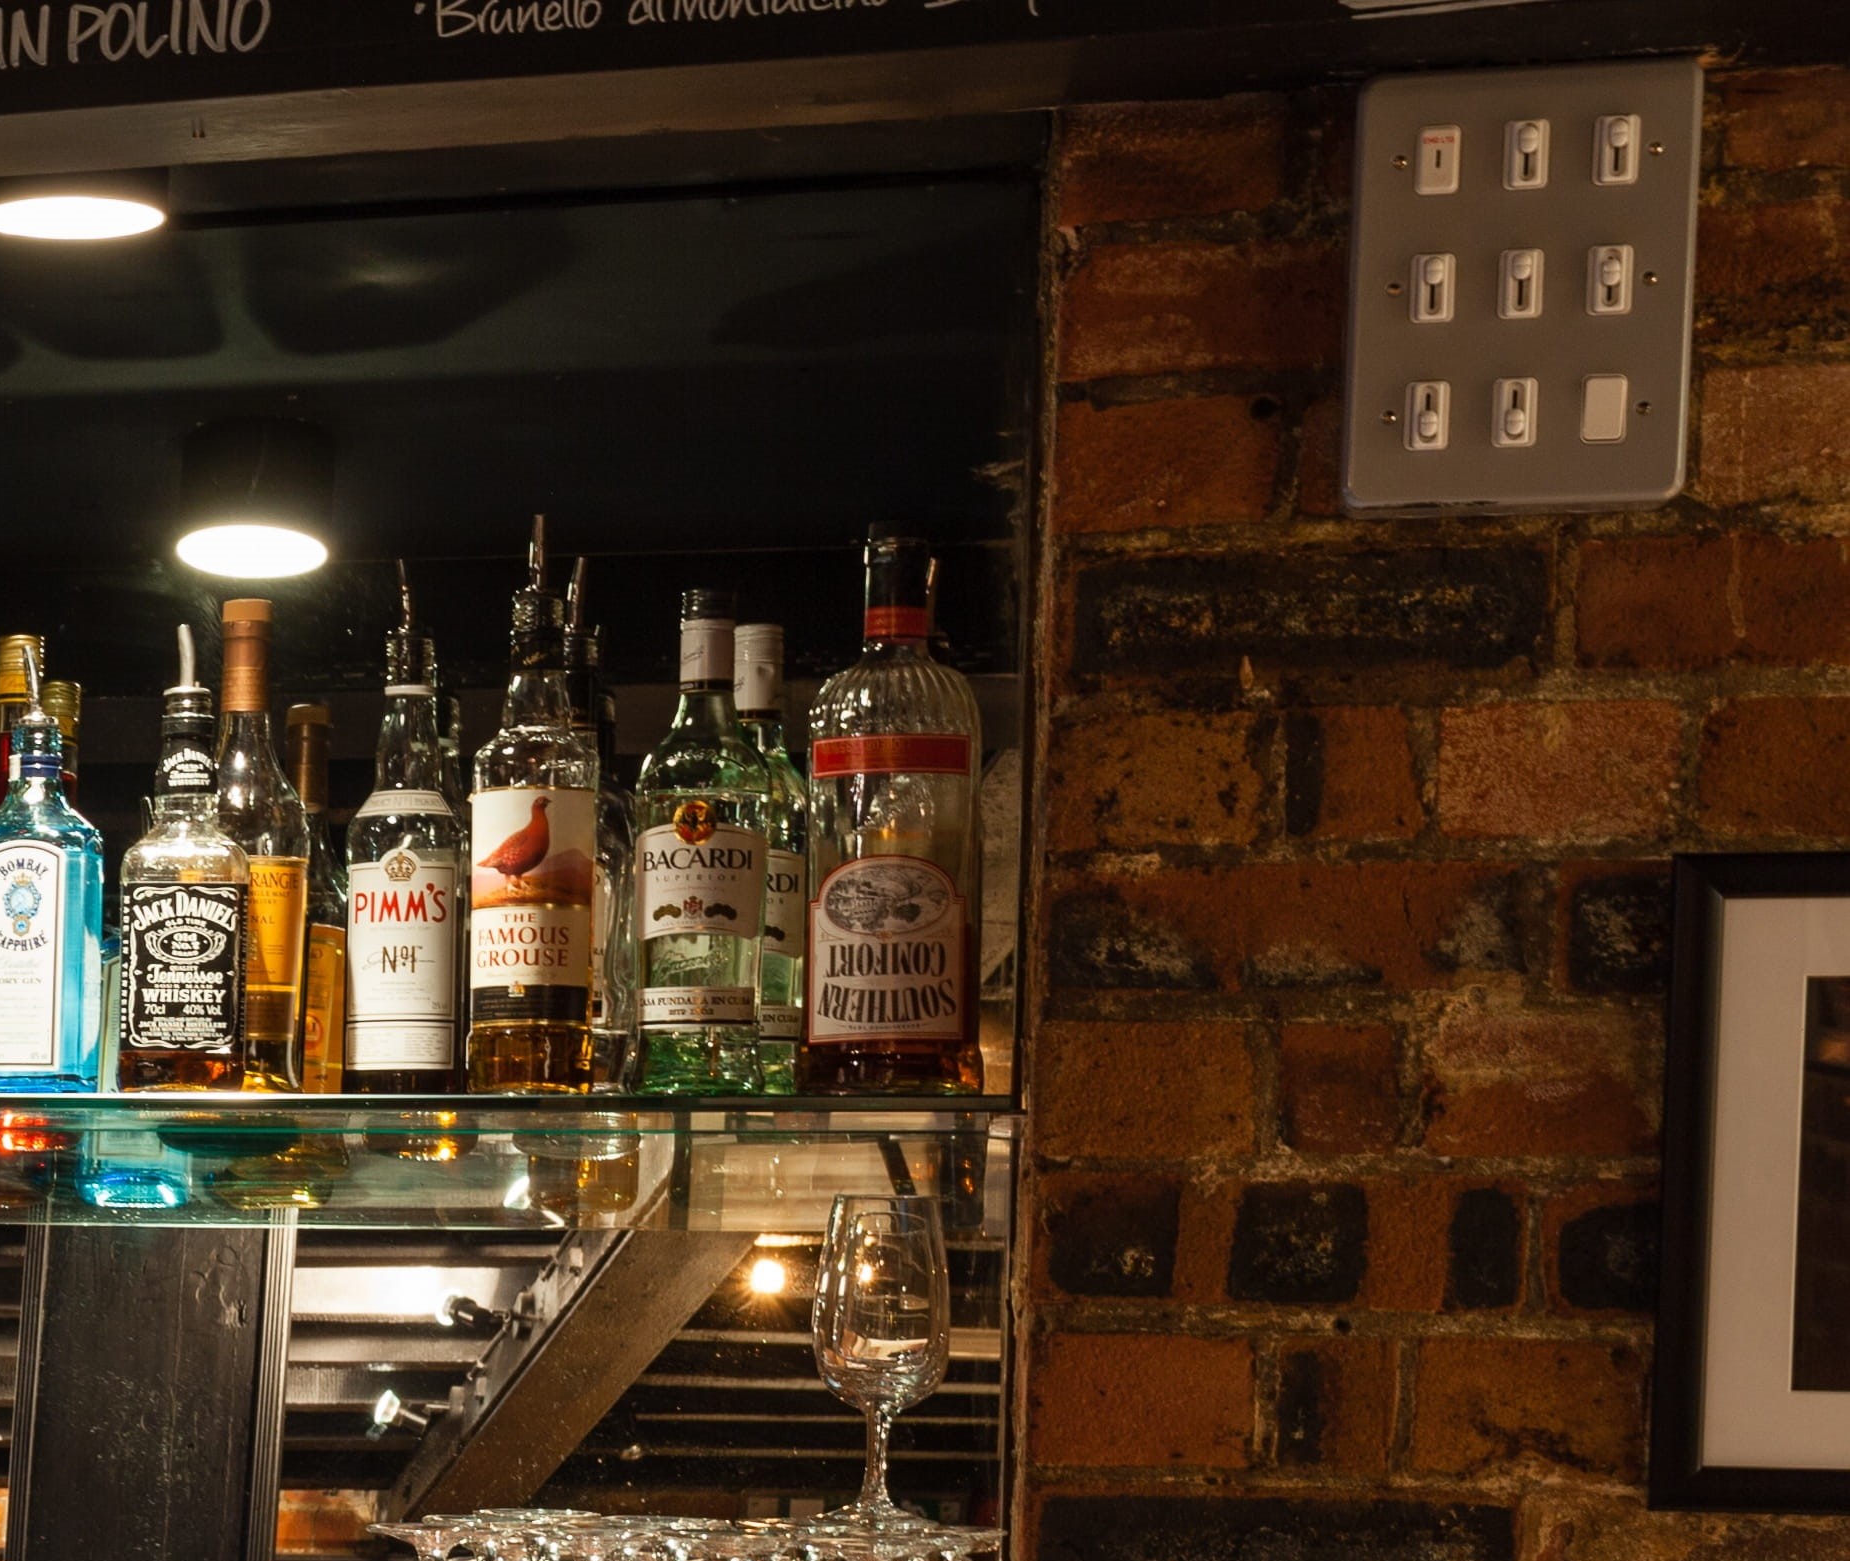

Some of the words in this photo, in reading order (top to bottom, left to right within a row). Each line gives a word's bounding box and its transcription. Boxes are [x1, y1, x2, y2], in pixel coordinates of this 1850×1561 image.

[64, 0, 267, 65] POLINO
[643, 848, 752, 872] BACARDI
[655, 874, 737, 883] SUPERIOR
[354, 882, 448, 924] PIMM'S
[132, 898, 174, 931] JACK
[503, 912, 538, 923] THE
[478, 926, 570, 946] FAMOUS
[477, 948, 569, 968] GROUSE
[827, 941, 946, 978] COMFORT
[146, 964, 223, 984] Tennessee
[141, 988, 226, 1003] WHISKEY
[817, 978, 956, 1024] SOUTHERN
[144, 1004, 166, 1015] 70cl
